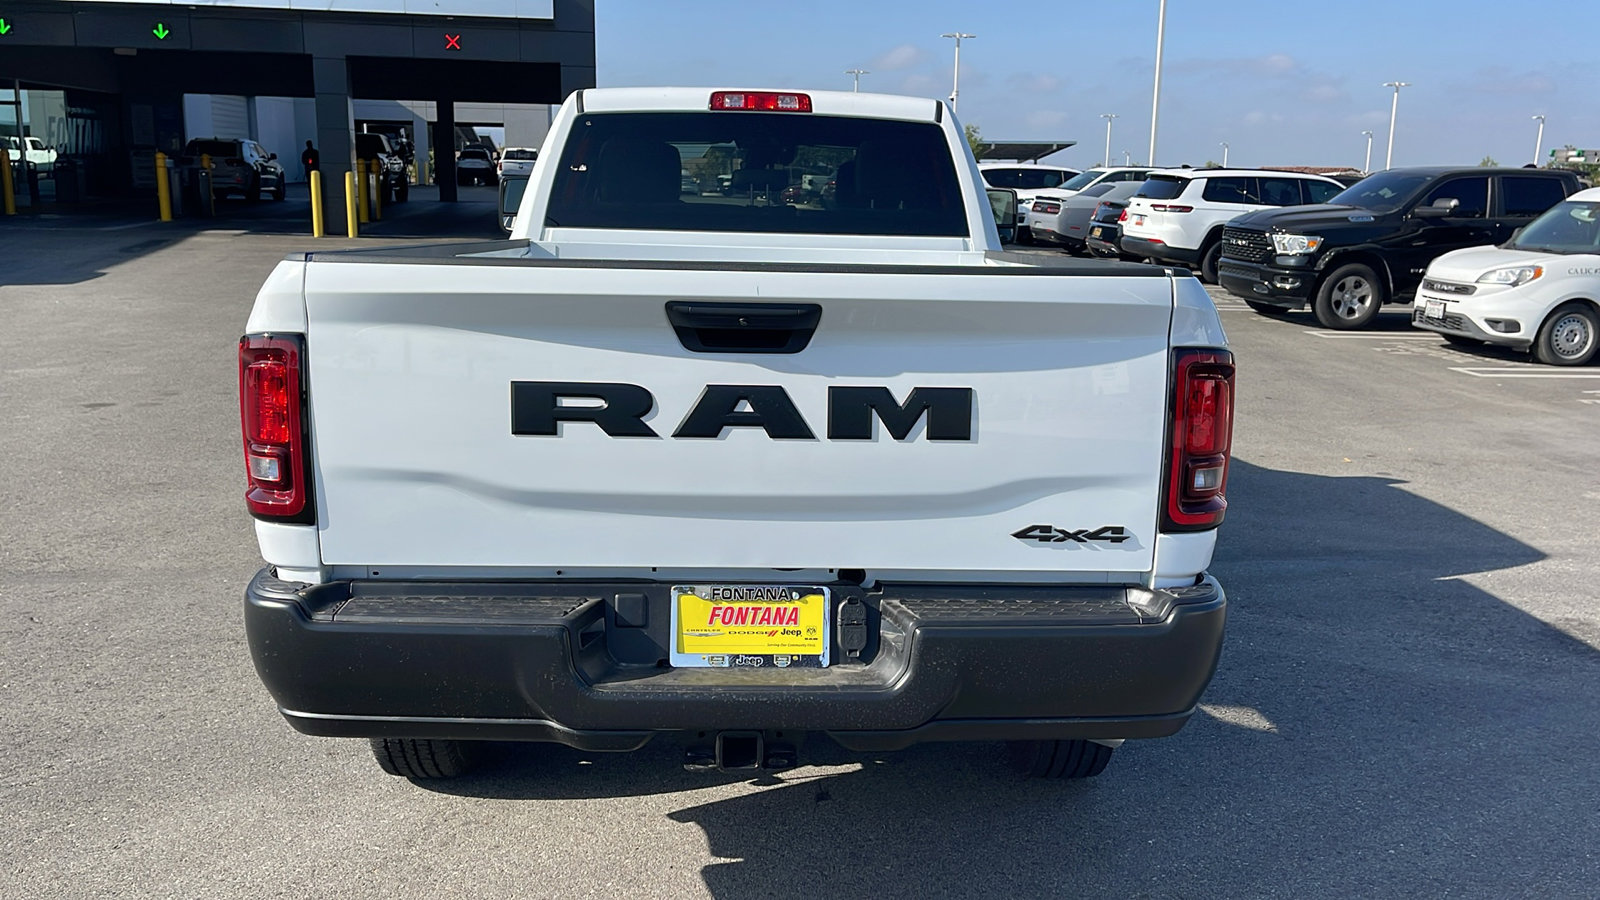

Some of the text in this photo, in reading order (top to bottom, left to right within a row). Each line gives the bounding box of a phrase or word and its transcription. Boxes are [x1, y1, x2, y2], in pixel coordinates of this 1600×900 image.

[1433, 283, 1456, 291] RAM
[510, 380, 973, 440] RAM
[1010, 524, 1131, 543] 4x4
[710, 587, 791, 601] FONTANA
[707, 606, 800, 626] FONTANA
[780, 628, 802, 637] Jeep
[736, 654, 763, 667] Jeep
